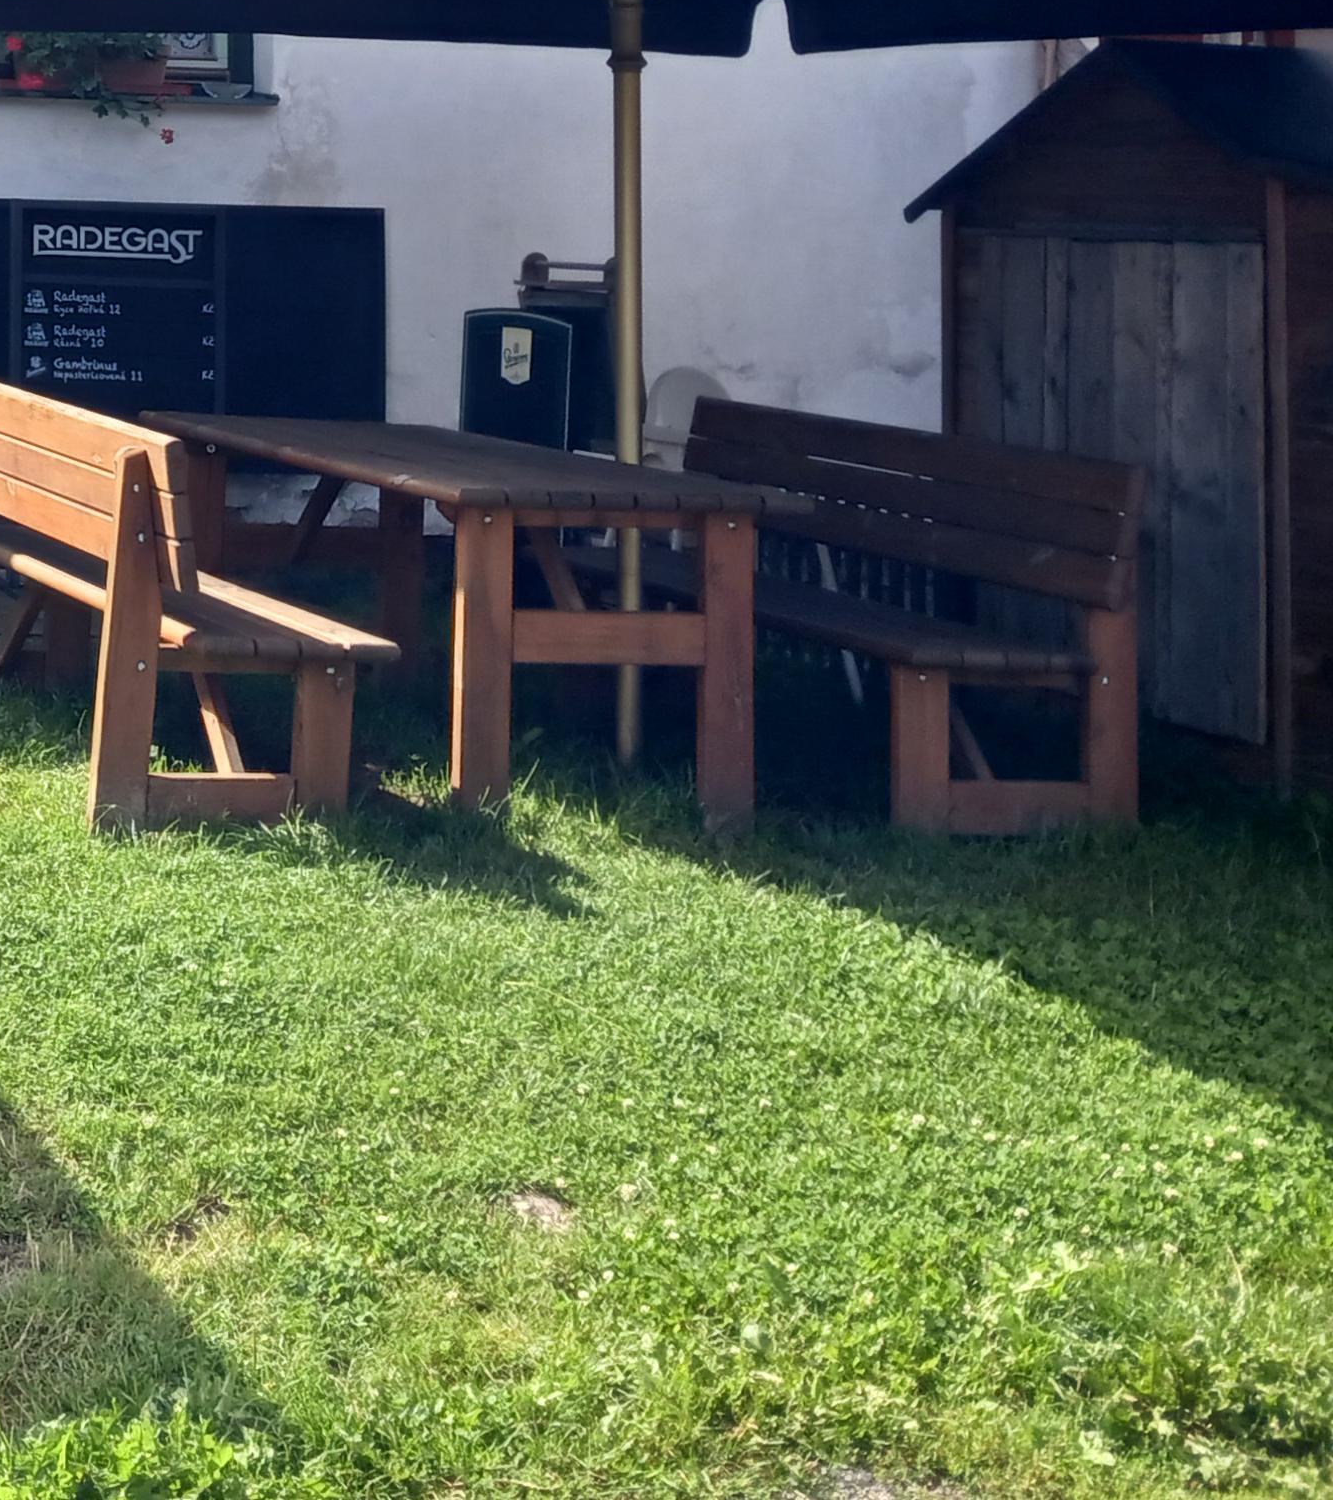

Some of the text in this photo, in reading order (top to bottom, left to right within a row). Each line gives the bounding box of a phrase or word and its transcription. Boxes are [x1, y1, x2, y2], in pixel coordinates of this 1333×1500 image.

[32, 224, 204, 264] RADEGAST
[53, 289, 106, 306] Radegast
[109, 304, 121, 315] 12
[53, 324, 106, 341] Radegast
[91, 338, 104, 348] 10
[53, 356, 118, 371] Gambrinus
[130, 370, 143, 382] 11
